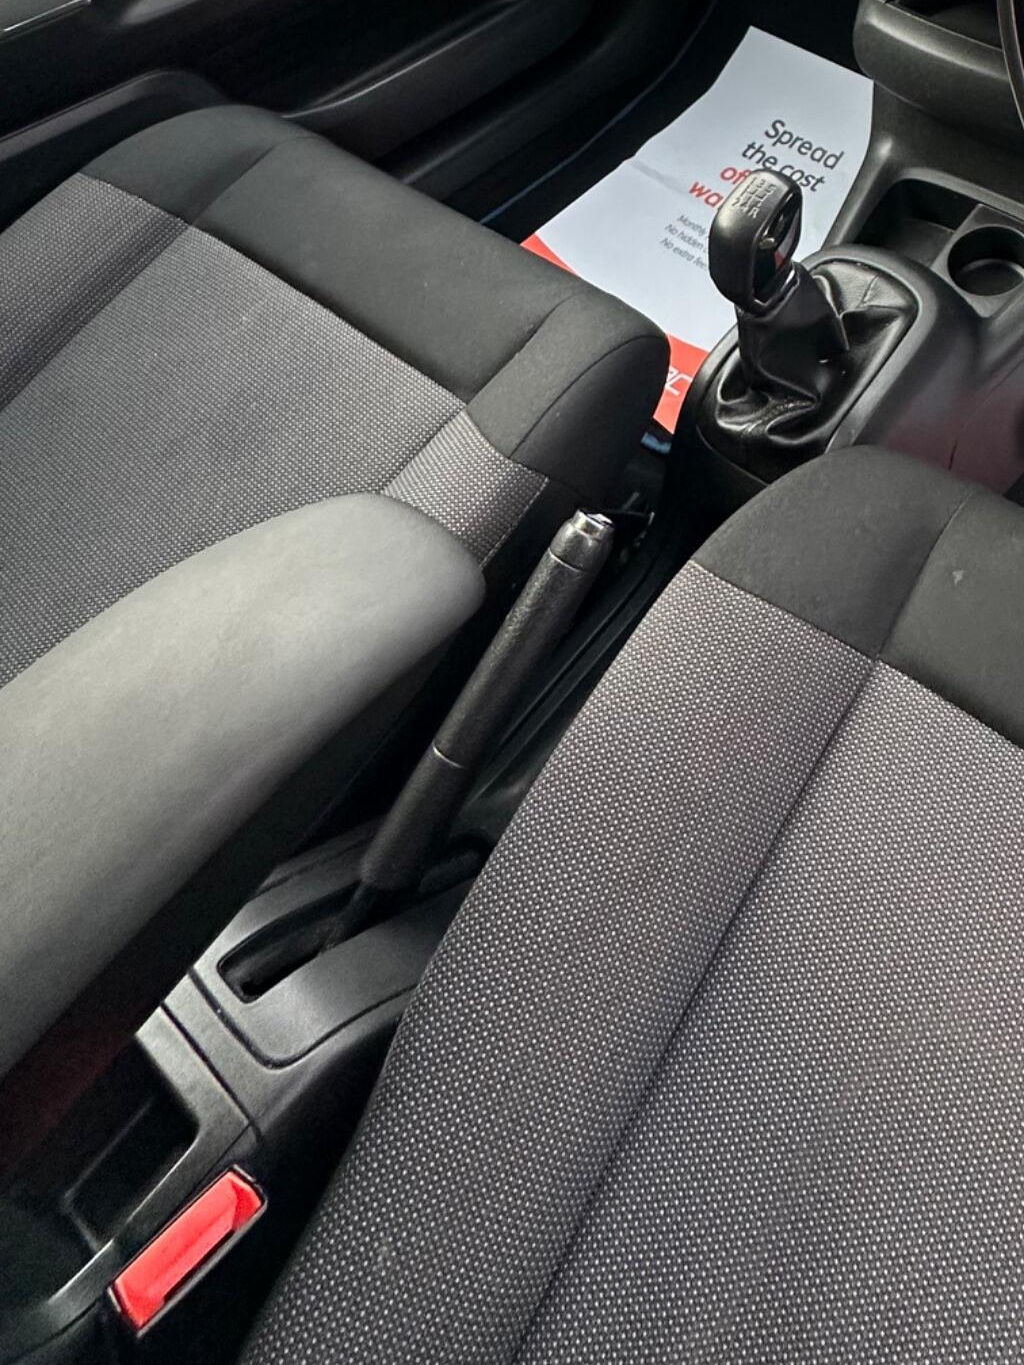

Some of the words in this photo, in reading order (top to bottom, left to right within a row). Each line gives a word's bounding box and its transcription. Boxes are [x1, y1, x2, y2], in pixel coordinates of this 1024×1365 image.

[764, 119, 845, 170] Spread
[741, 141, 778, 170] the
[779, 163, 826, 192] cost
[660, 238, 674, 249] No
[665, 224, 679, 236] No
